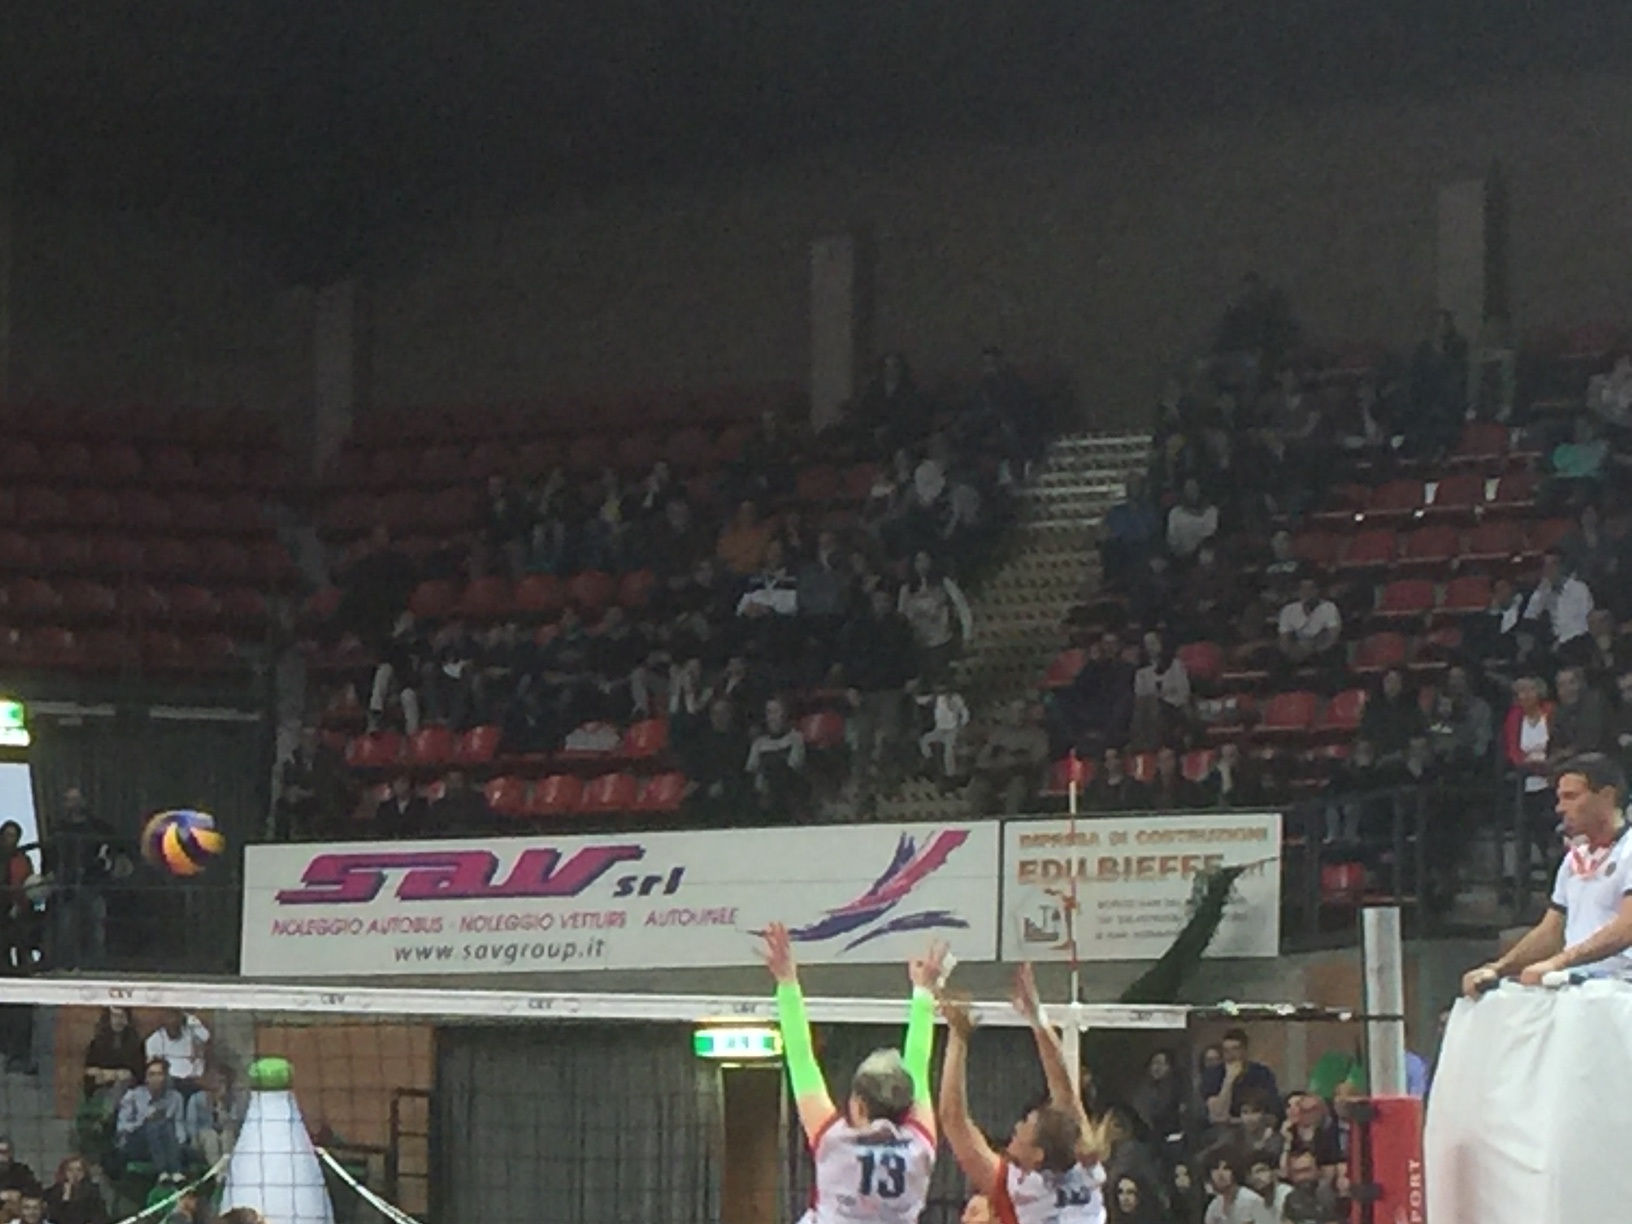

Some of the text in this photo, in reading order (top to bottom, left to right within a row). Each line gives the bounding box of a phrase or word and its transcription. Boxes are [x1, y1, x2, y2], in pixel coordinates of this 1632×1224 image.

[612, 866, 686, 898] srl
[271, 918, 364, 937] NOLEGGIO
[365, 915, 443, 935] AUTOBUS
[459, 912, 553, 933] NOLEGGIO
[393, 938, 606, 965] wwwsavgroup.it
[856, 1152, 906, 1199] 13
